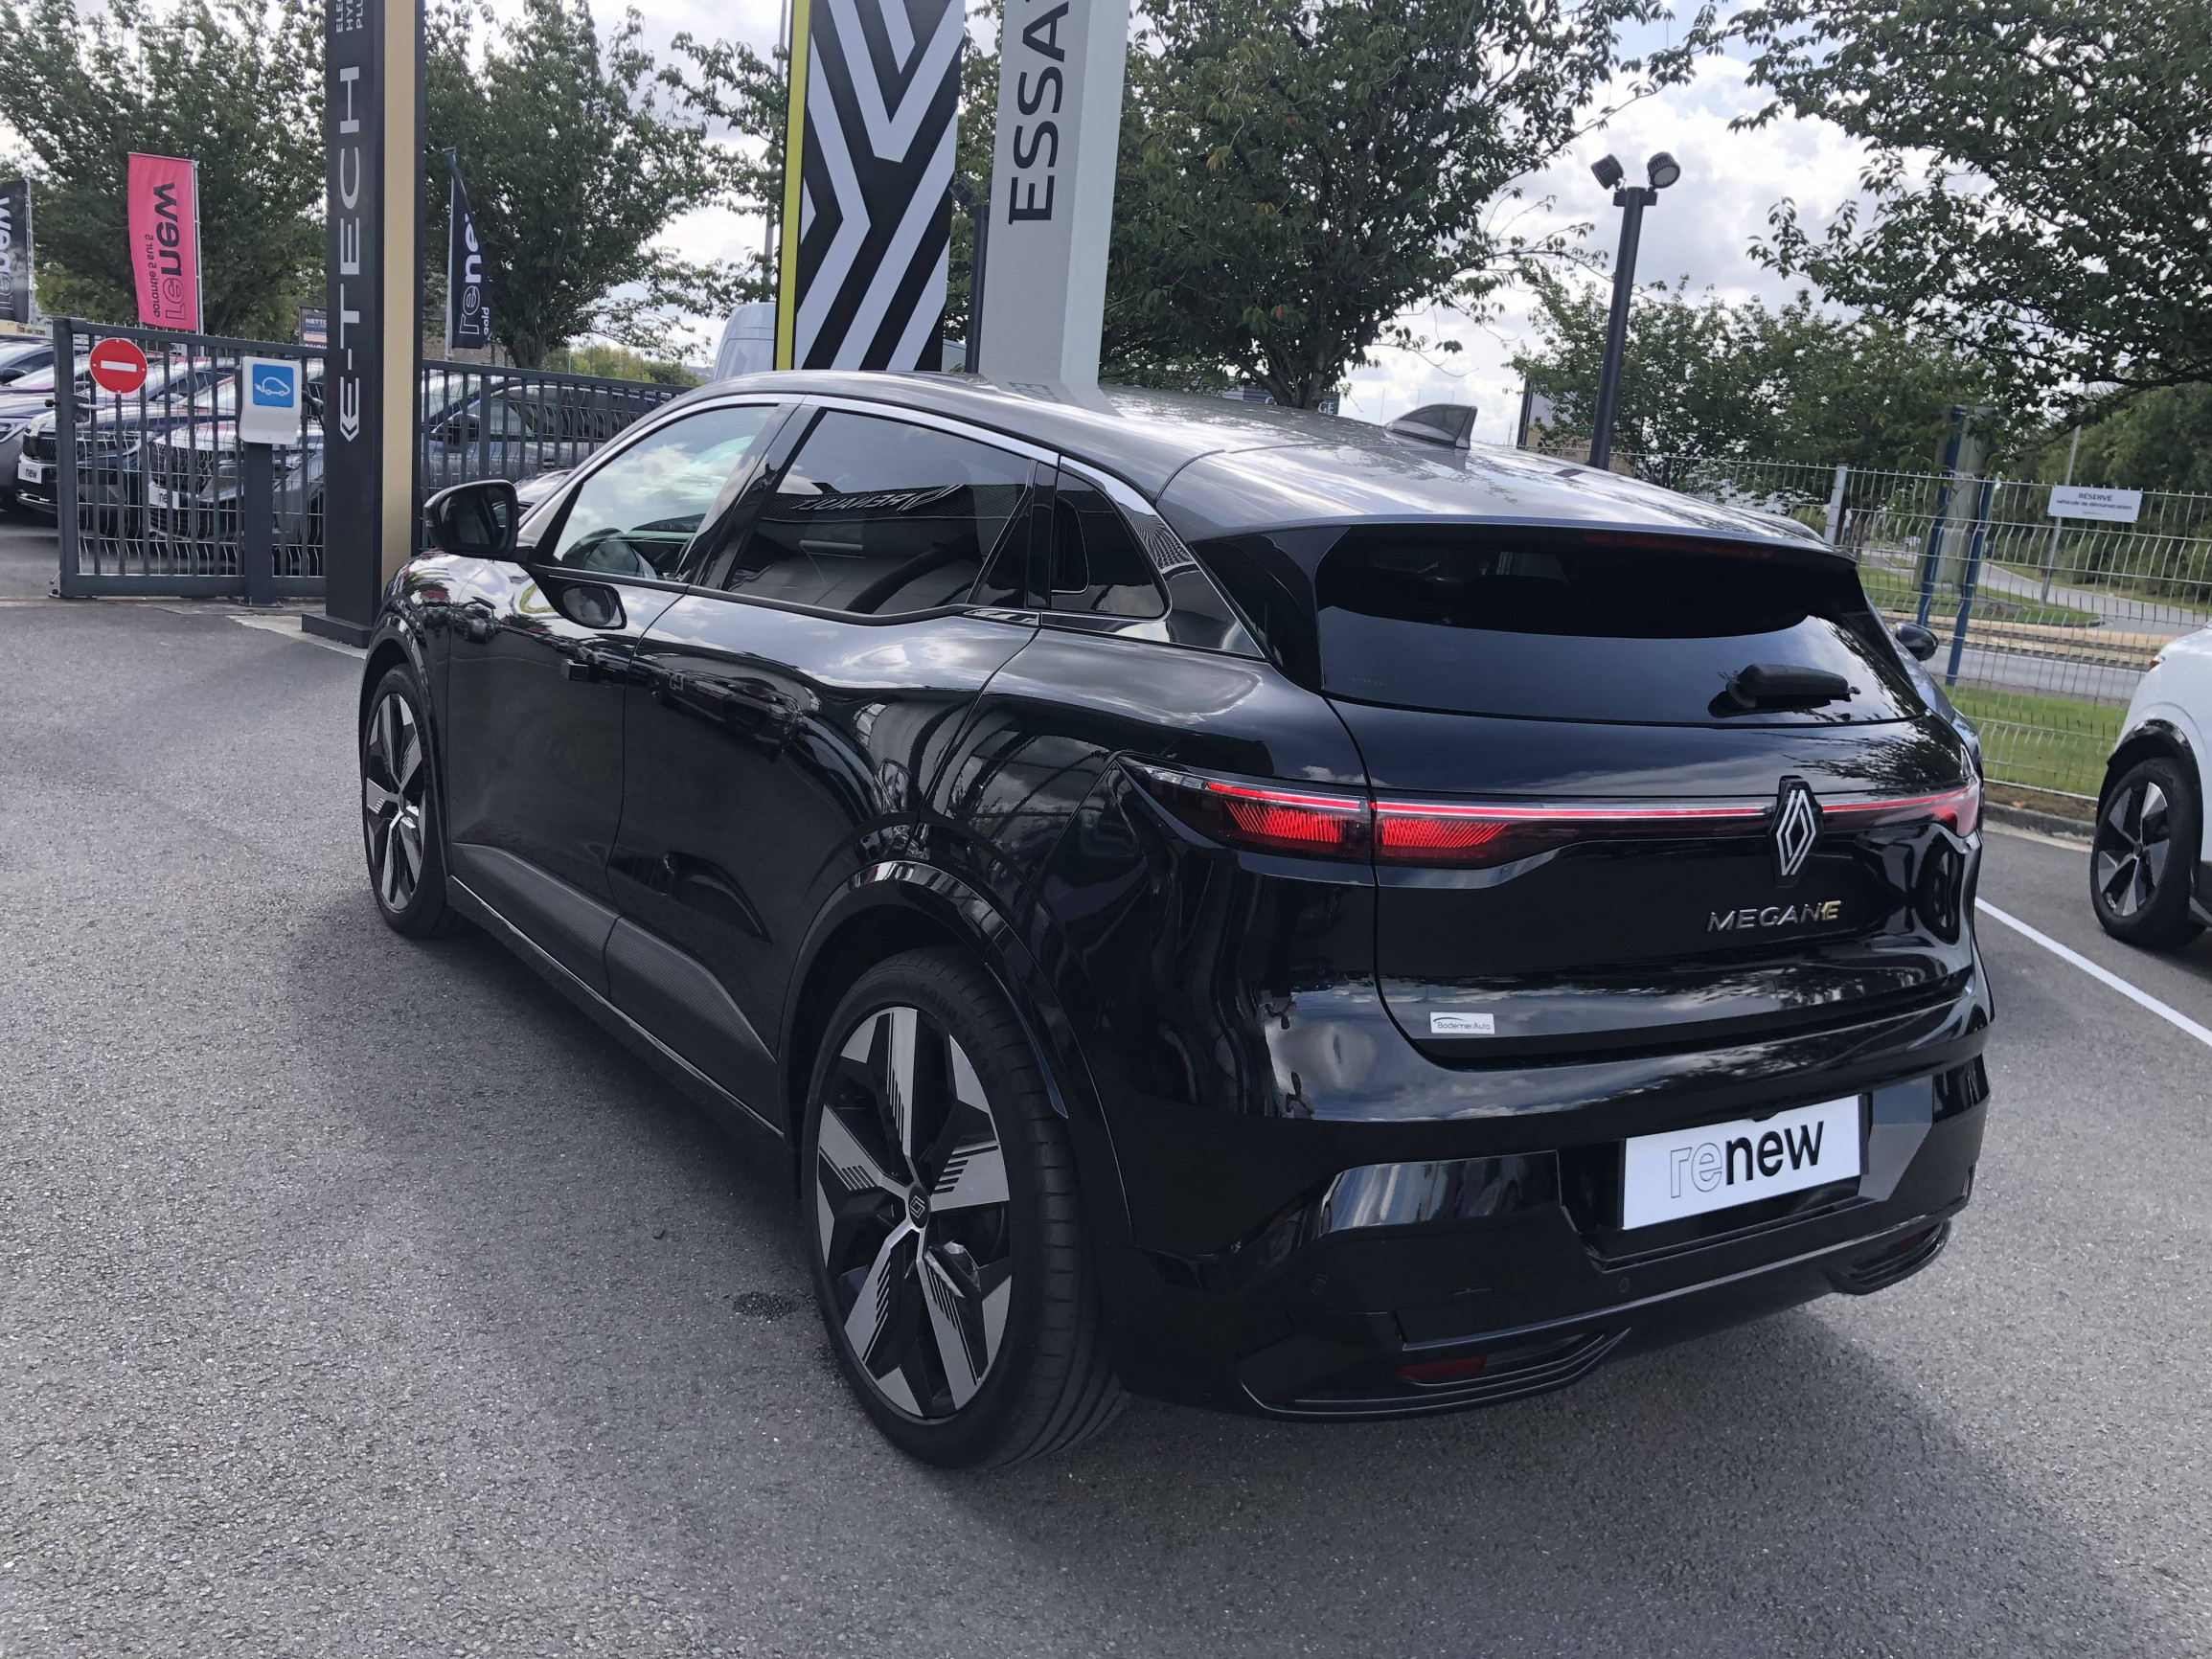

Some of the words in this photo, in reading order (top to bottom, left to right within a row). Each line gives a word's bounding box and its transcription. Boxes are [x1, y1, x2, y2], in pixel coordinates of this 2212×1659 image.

[335, 0, 344, 33] ELE
[1008, 0, 1070, 225] ESSA
[339, 66, 360, 443] E-TECH
[459, 213, 482, 335] rene
[481, 307, 490, 336] gold
[2078, 492, 2113, 502] RÉSERVÉ
[2088, 501, 2132, 511] démonstration
[1706, 899, 1841, 932] MEGANE
[1670, 1120, 1824, 1199] renew
